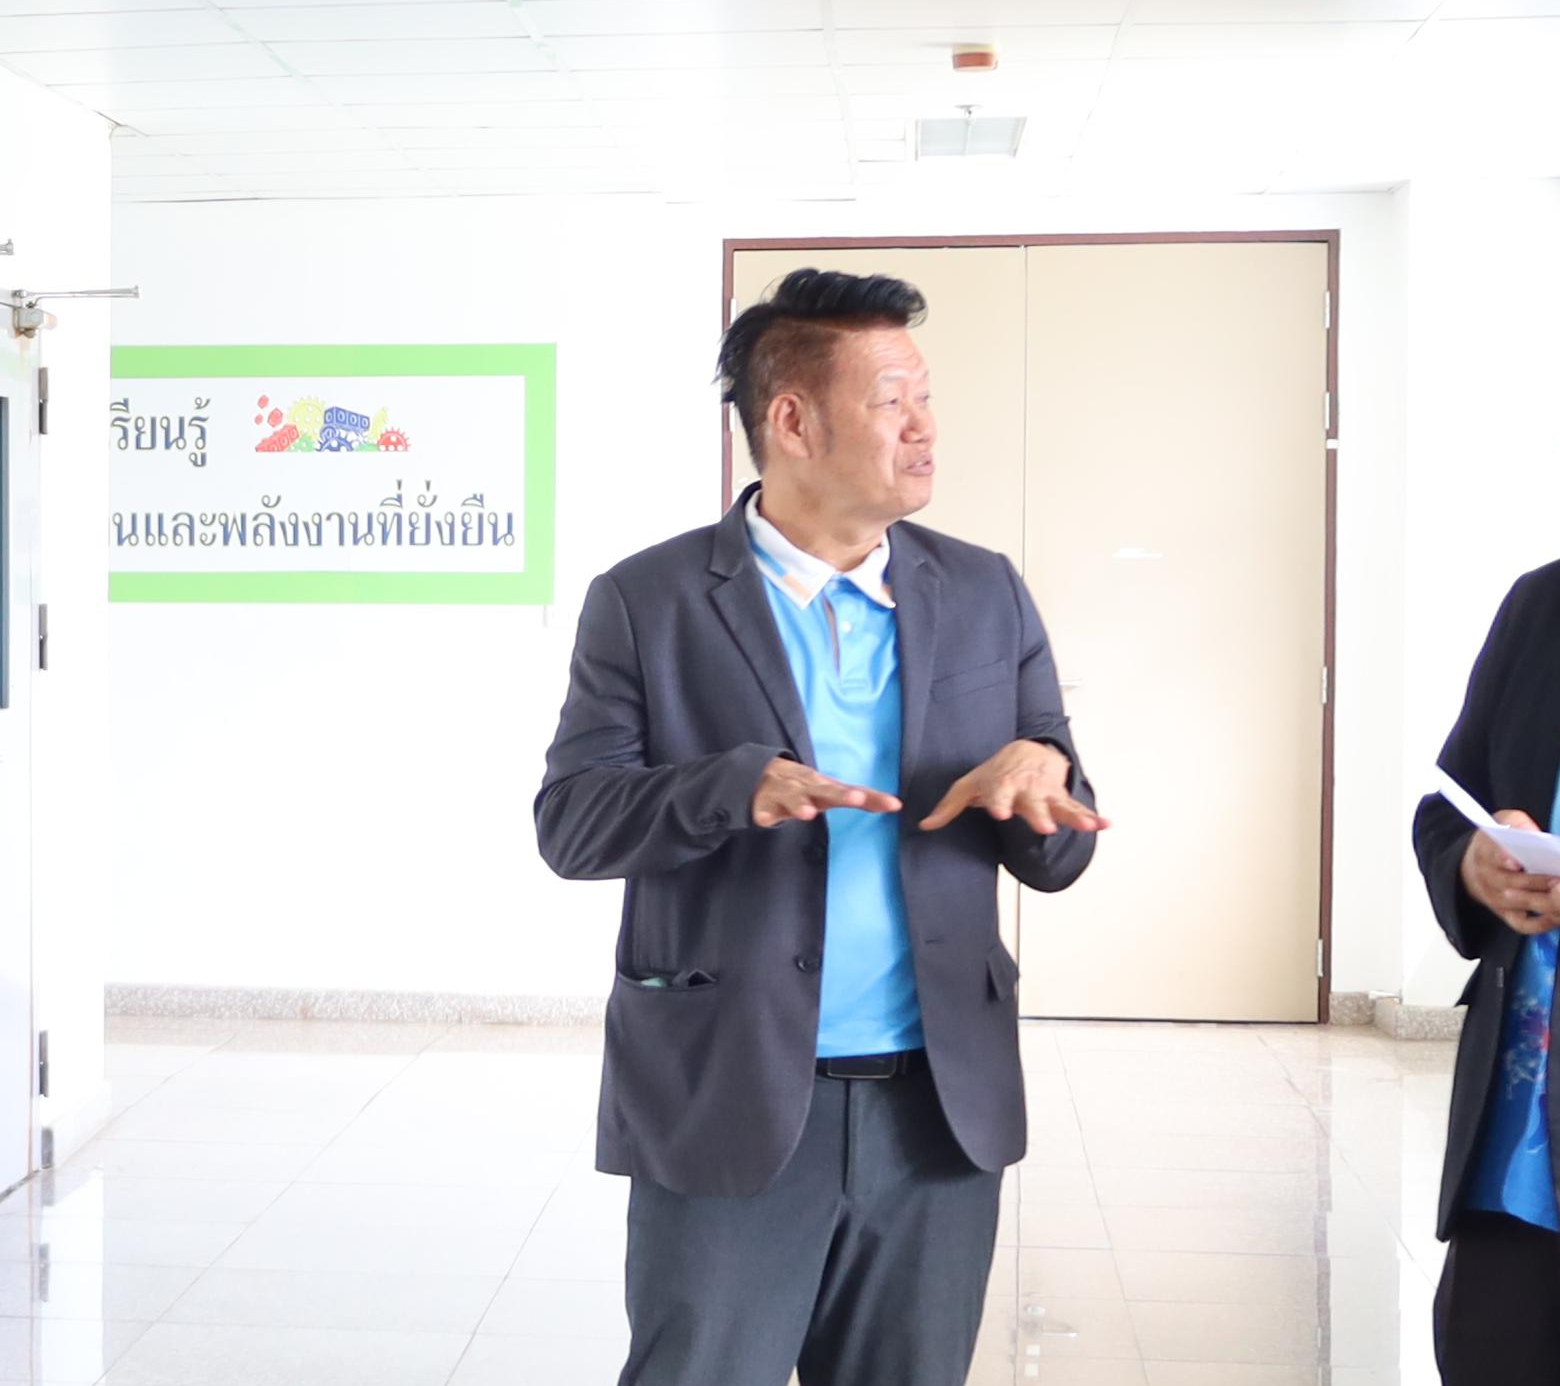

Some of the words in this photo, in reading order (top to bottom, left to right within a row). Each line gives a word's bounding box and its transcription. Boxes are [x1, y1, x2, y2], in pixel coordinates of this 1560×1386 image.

[110, 396, 212, 468] รียนรู้
[109, 478, 516, 548] นและพลังงานที่ยั่งยืน
